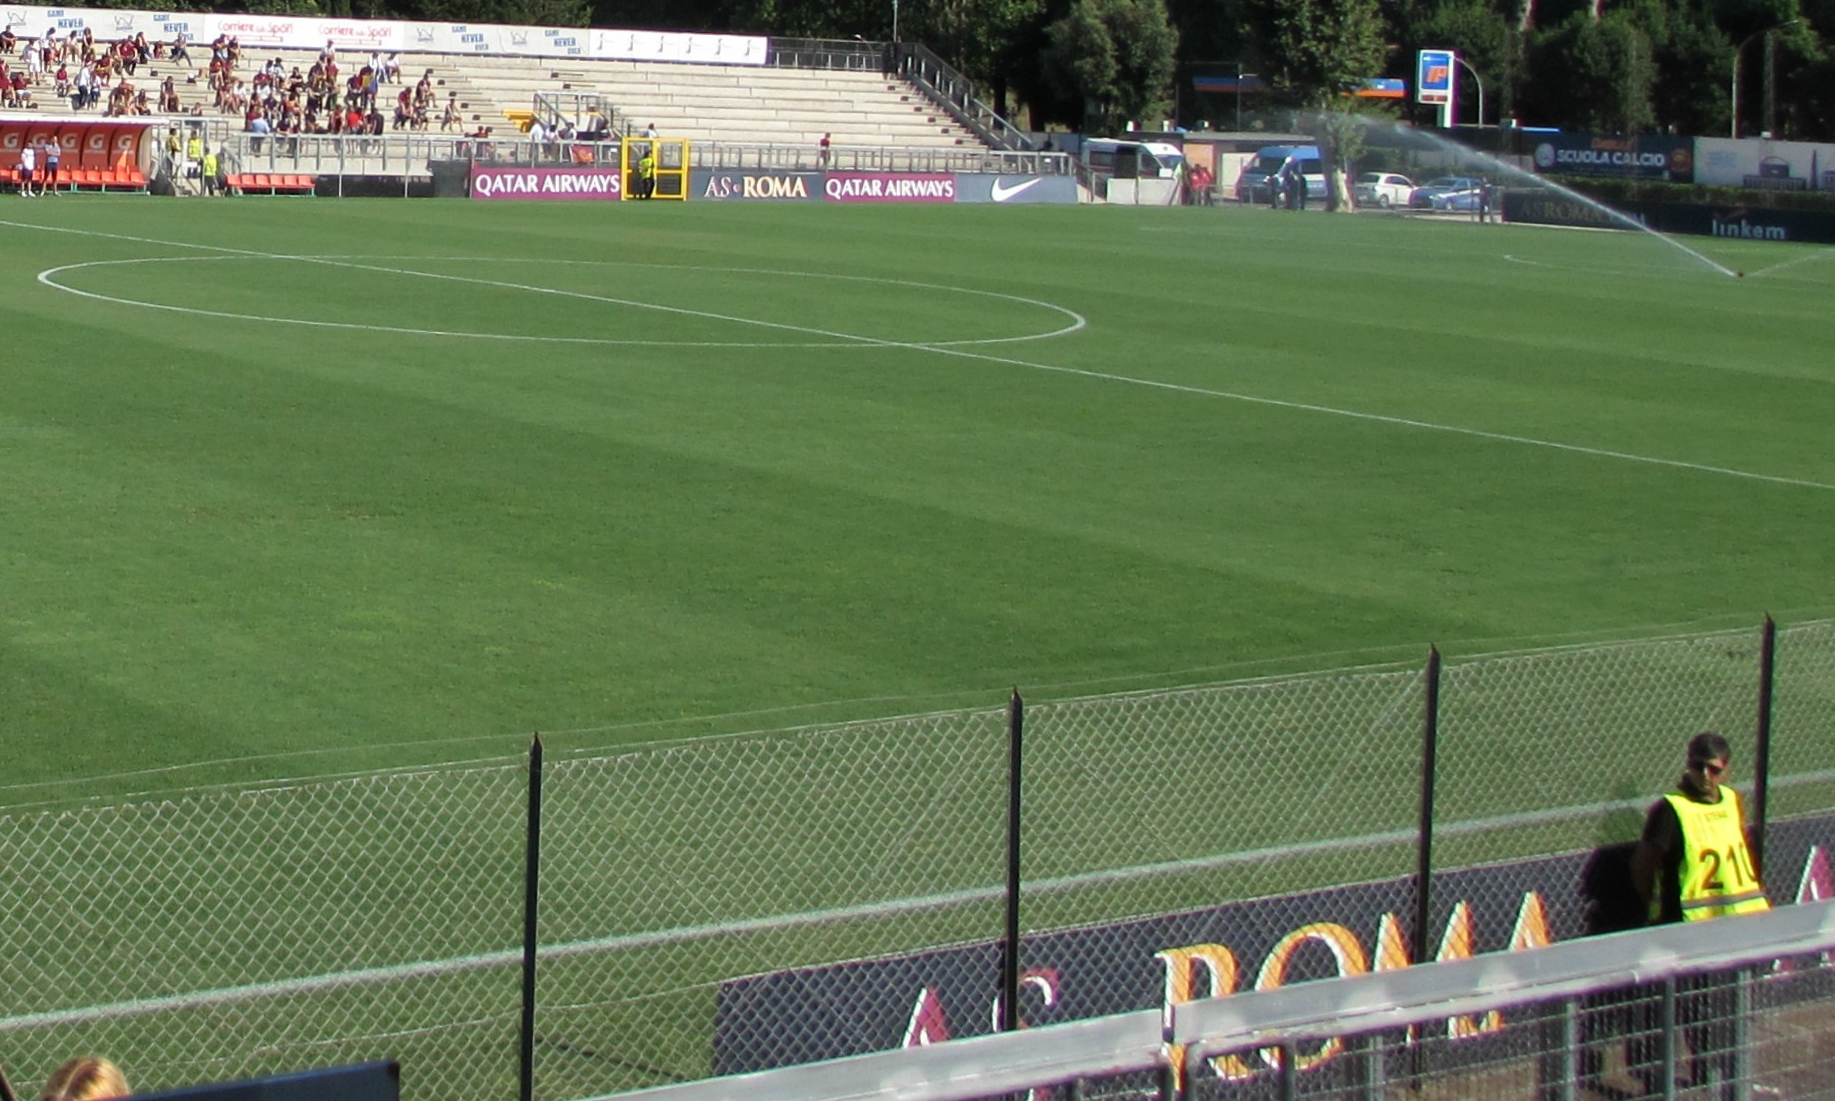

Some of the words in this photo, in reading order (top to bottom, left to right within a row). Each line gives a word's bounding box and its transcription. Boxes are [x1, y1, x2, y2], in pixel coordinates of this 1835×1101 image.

[1557, 150, 1611, 164] SCUOLA
[1613, 152, 1665, 167] CALCIO
[475, 174, 539, 197] QATAR
[541, 174, 620, 193] AIRWAYS
[704, 175, 731, 199] AS
[742, 175, 808, 198] ROMA
[825, 178, 883, 200] QATAR
[884, 179, 954, 198] AIRWAYS
[1711, 218, 1786, 240] linkem
